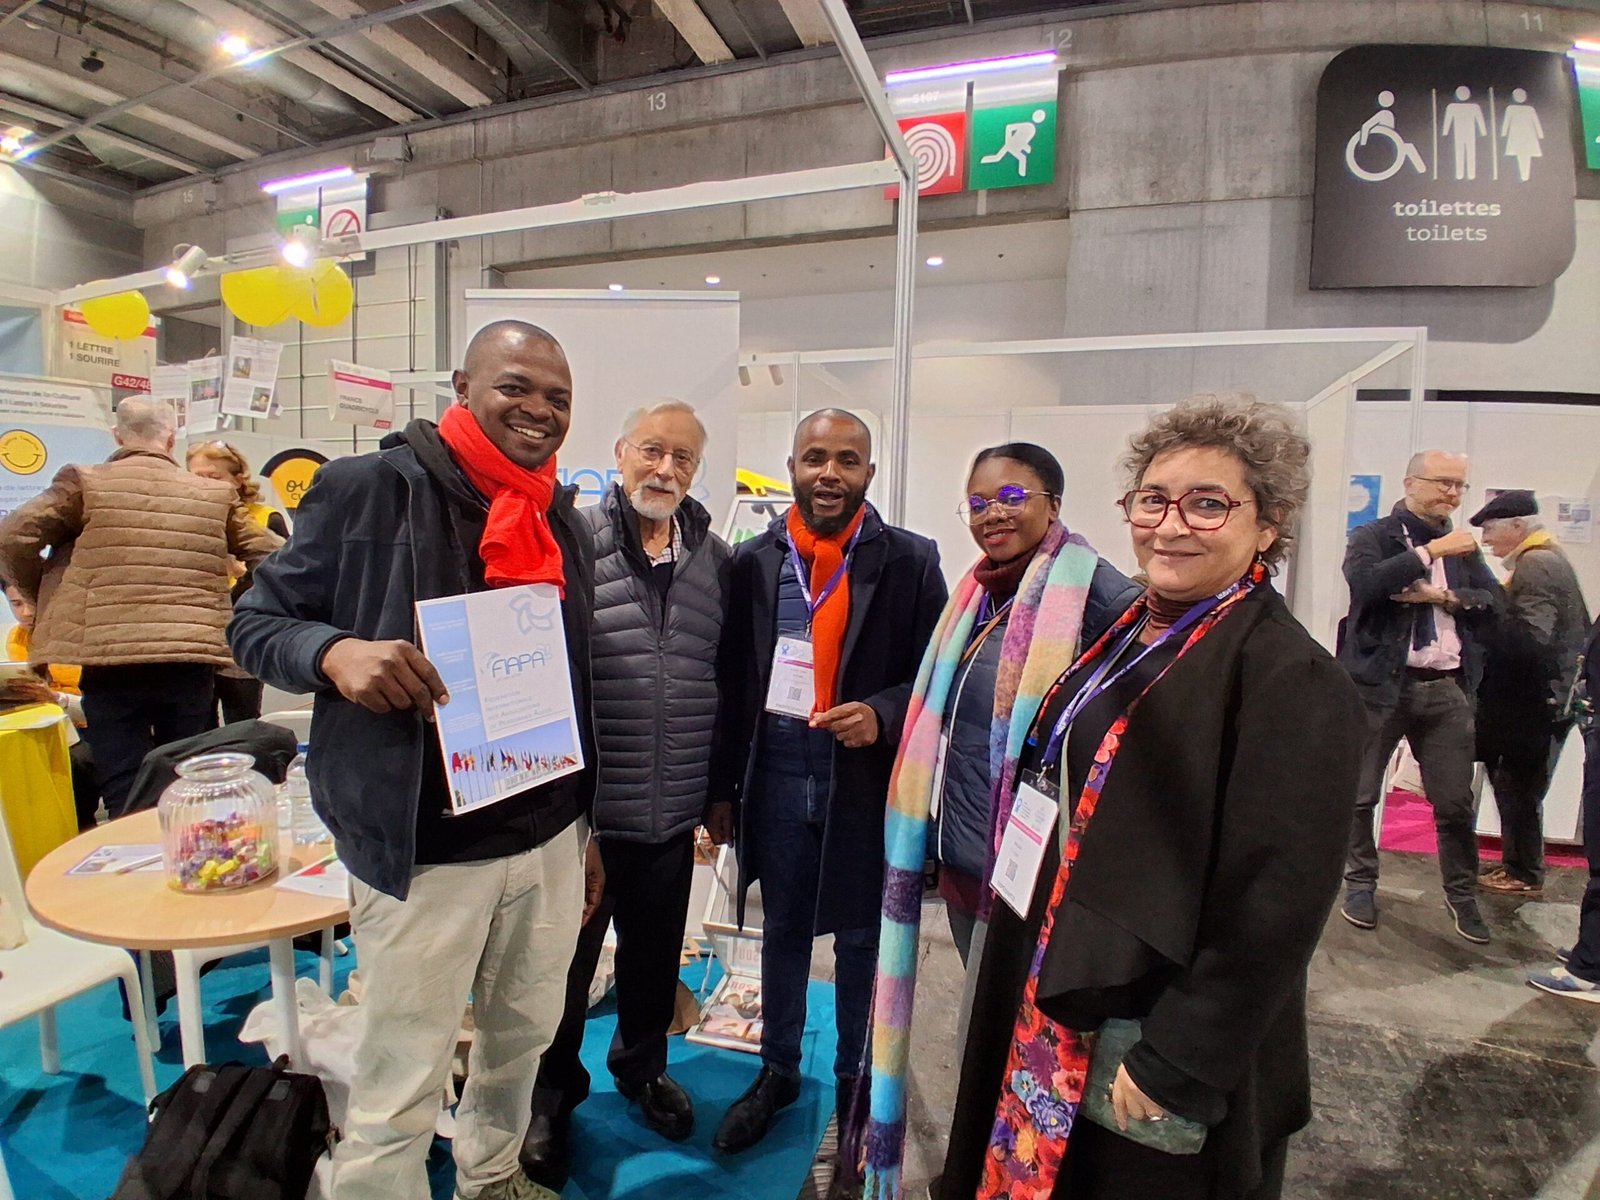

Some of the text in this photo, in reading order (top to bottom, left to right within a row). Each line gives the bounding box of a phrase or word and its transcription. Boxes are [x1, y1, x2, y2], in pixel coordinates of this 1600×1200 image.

[1520, 11, 1543, 32] 11
[1046, 28, 1073, 49] 12
[647, 92, 667, 111] 13
[1392, 199, 1501, 217] toilettes
[1406, 224, 1488, 241] toilets
[69, 340, 114, 356] 1 LETTRE
[76, 354, 121, 368] SOURIRE
[491, 651, 545, 678] FIAPA
